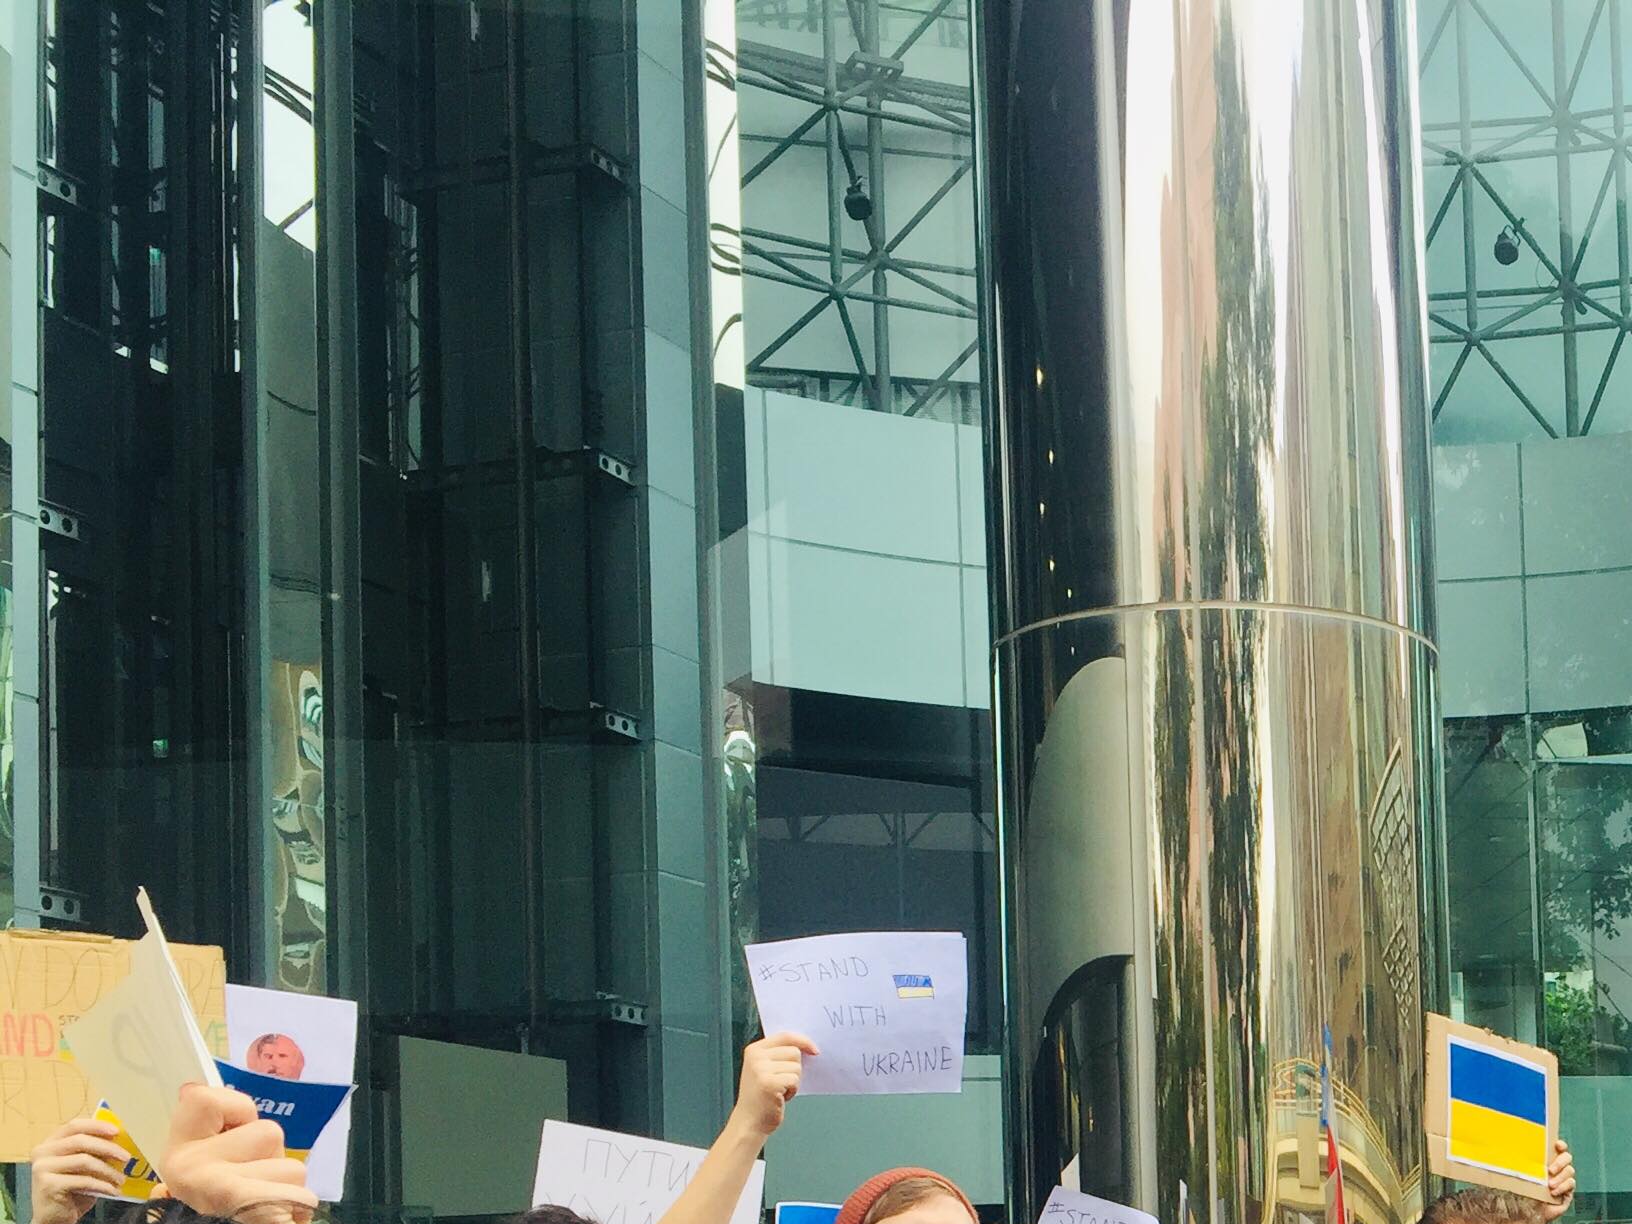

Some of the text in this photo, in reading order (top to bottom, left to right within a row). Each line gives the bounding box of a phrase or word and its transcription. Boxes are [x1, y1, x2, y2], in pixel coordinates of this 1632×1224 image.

[758, 956, 869, 983] #STAND
[824, 1005, 887, 1028] WITH
[862, 1046, 953, 1077] UKRAINE
[583, 1138, 690, 1192] ПУТИ
